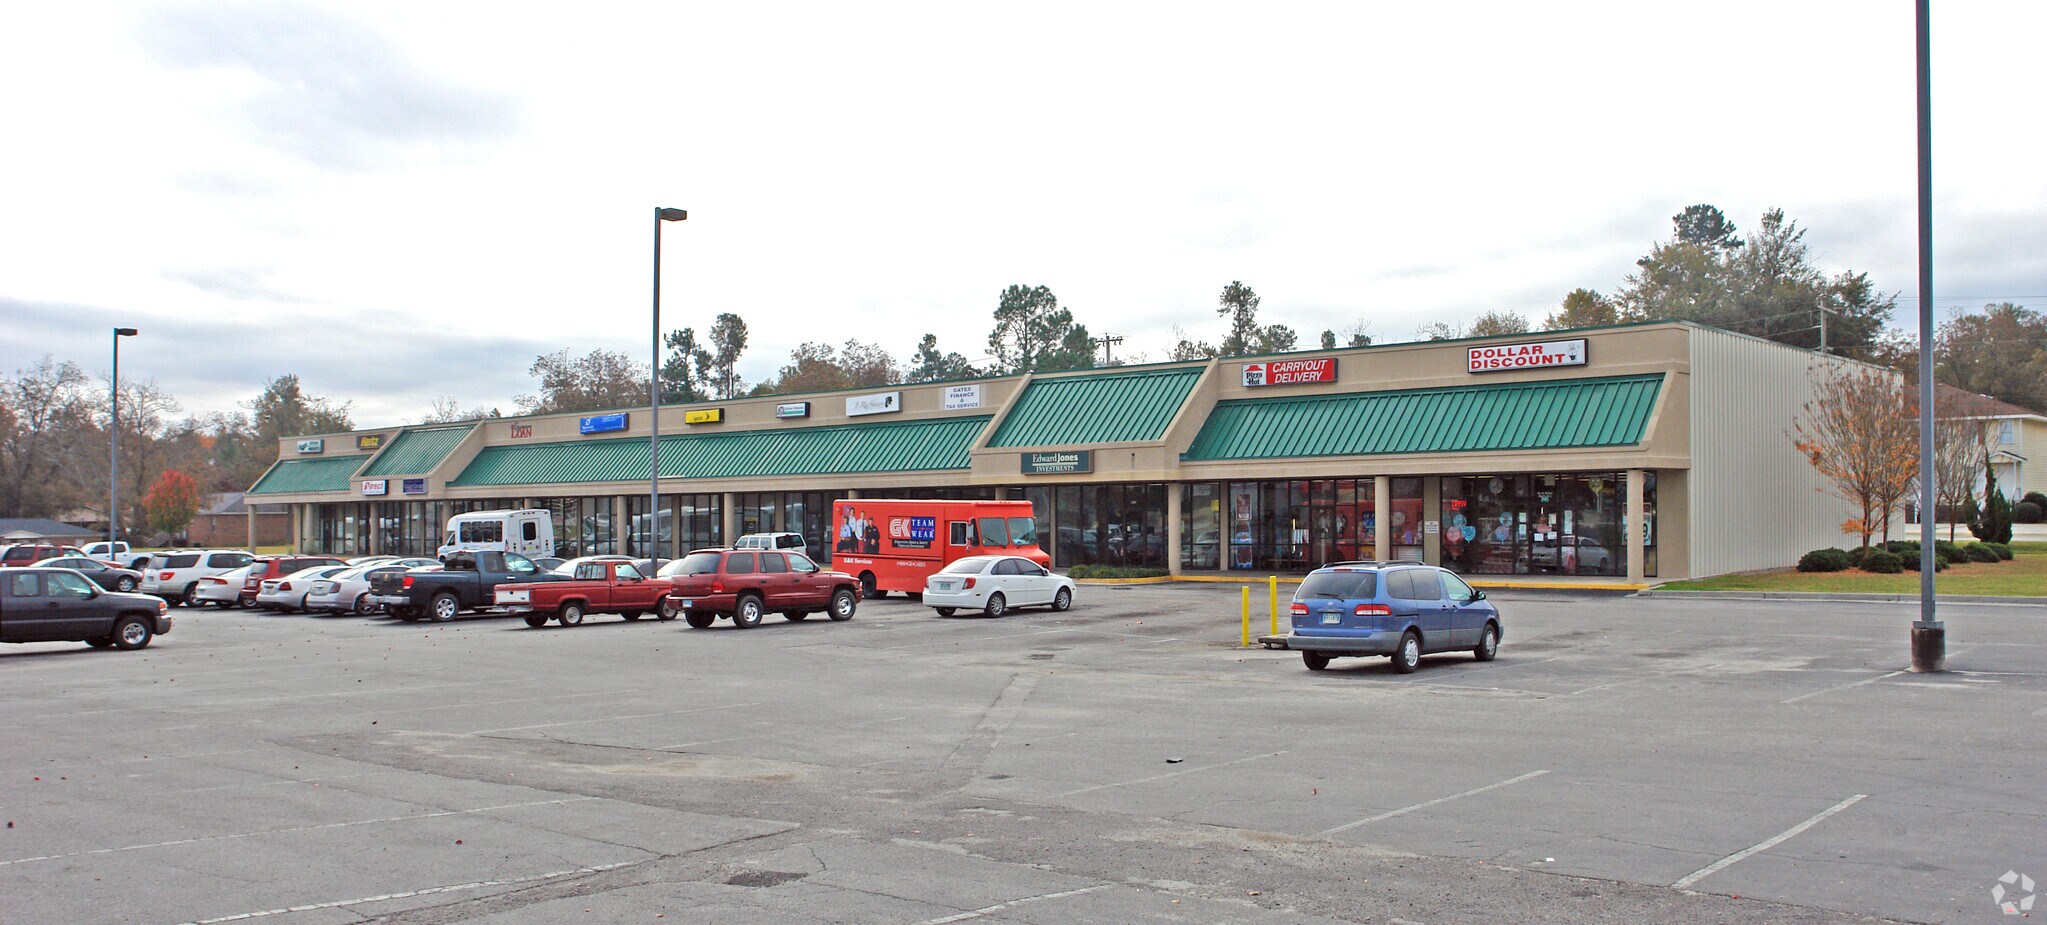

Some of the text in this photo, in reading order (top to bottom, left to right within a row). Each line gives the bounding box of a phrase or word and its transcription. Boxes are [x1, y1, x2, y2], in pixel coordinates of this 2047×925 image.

[1471, 345, 1544, 359] DOLLAR
[1272, 360, 1328, 373] CARRYOUT
[1471, 353, 1566, 369] DISCOUNT
[1246, 371, 1263, 379] Pizza
[1274, 371, 1323, 384] DELIVERY
[360, 436, 379, 447] Hertz
[911, 519, 934, 527] TEAM
[911, 530, 934, 538] WEAR
